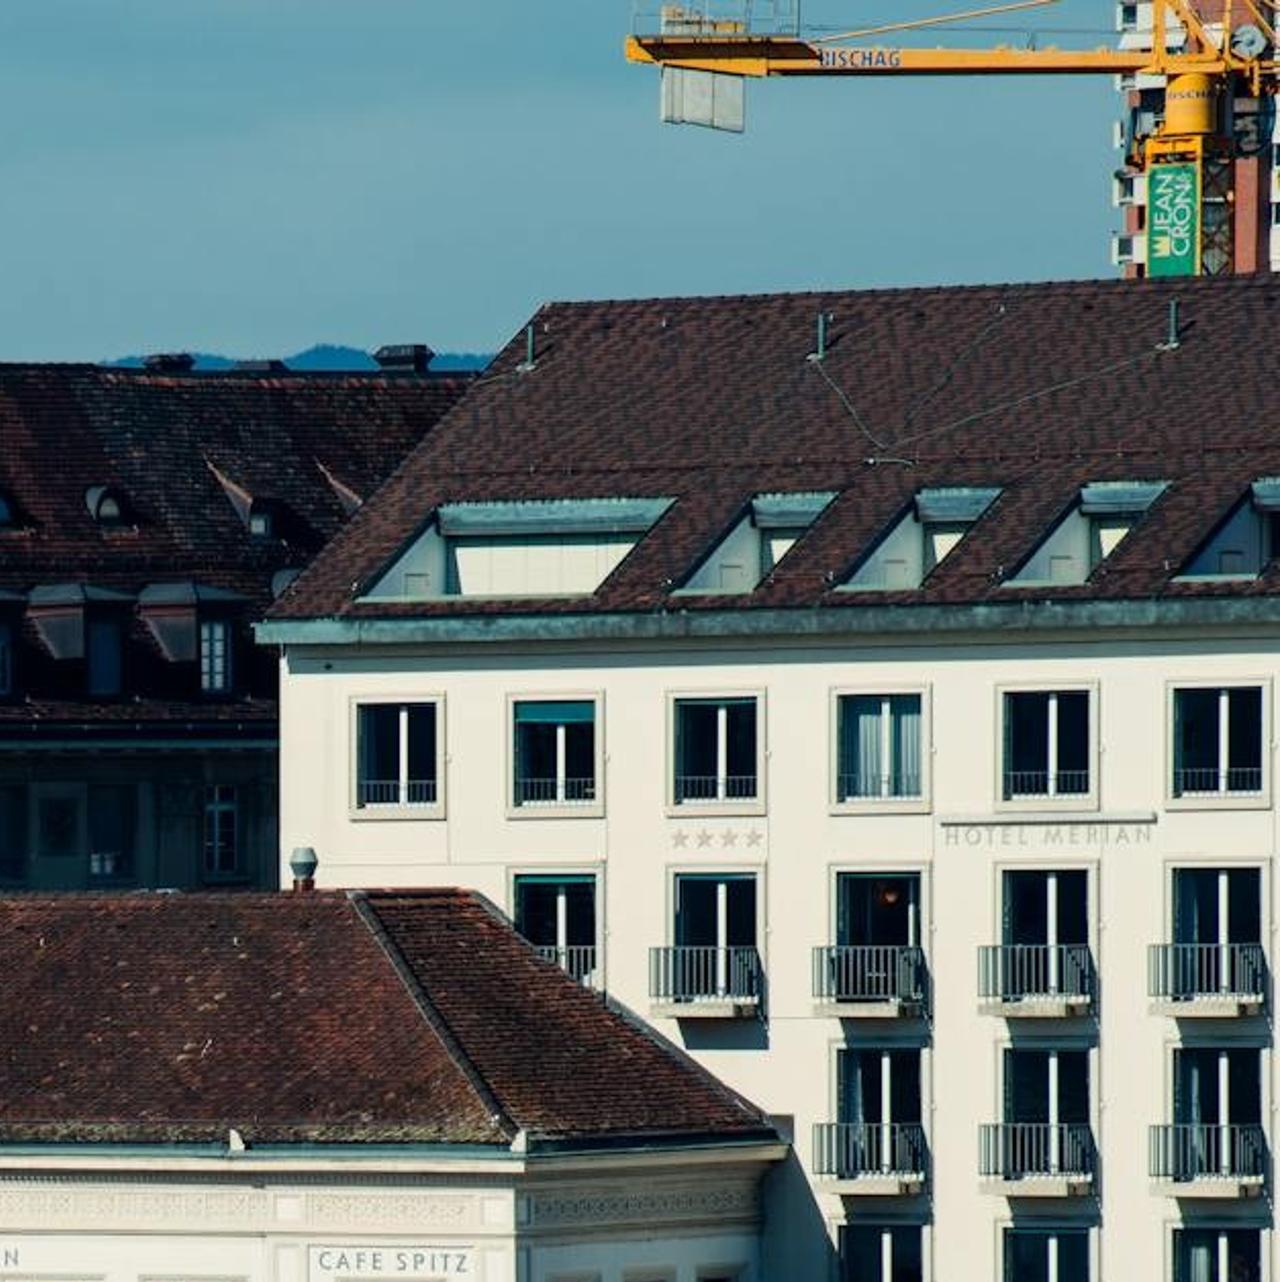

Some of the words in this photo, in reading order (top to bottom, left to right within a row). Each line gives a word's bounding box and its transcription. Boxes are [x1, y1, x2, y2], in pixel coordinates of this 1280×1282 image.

[1153, 174, 1173, 233] JEAN
[945, 826, 1028, 846] HOTEL
[1044, 825, 1151, 845] MERIAN
[319, 1251, 382, 1271] CAFE
[397, 1252, 468, 1273] SPITZ
